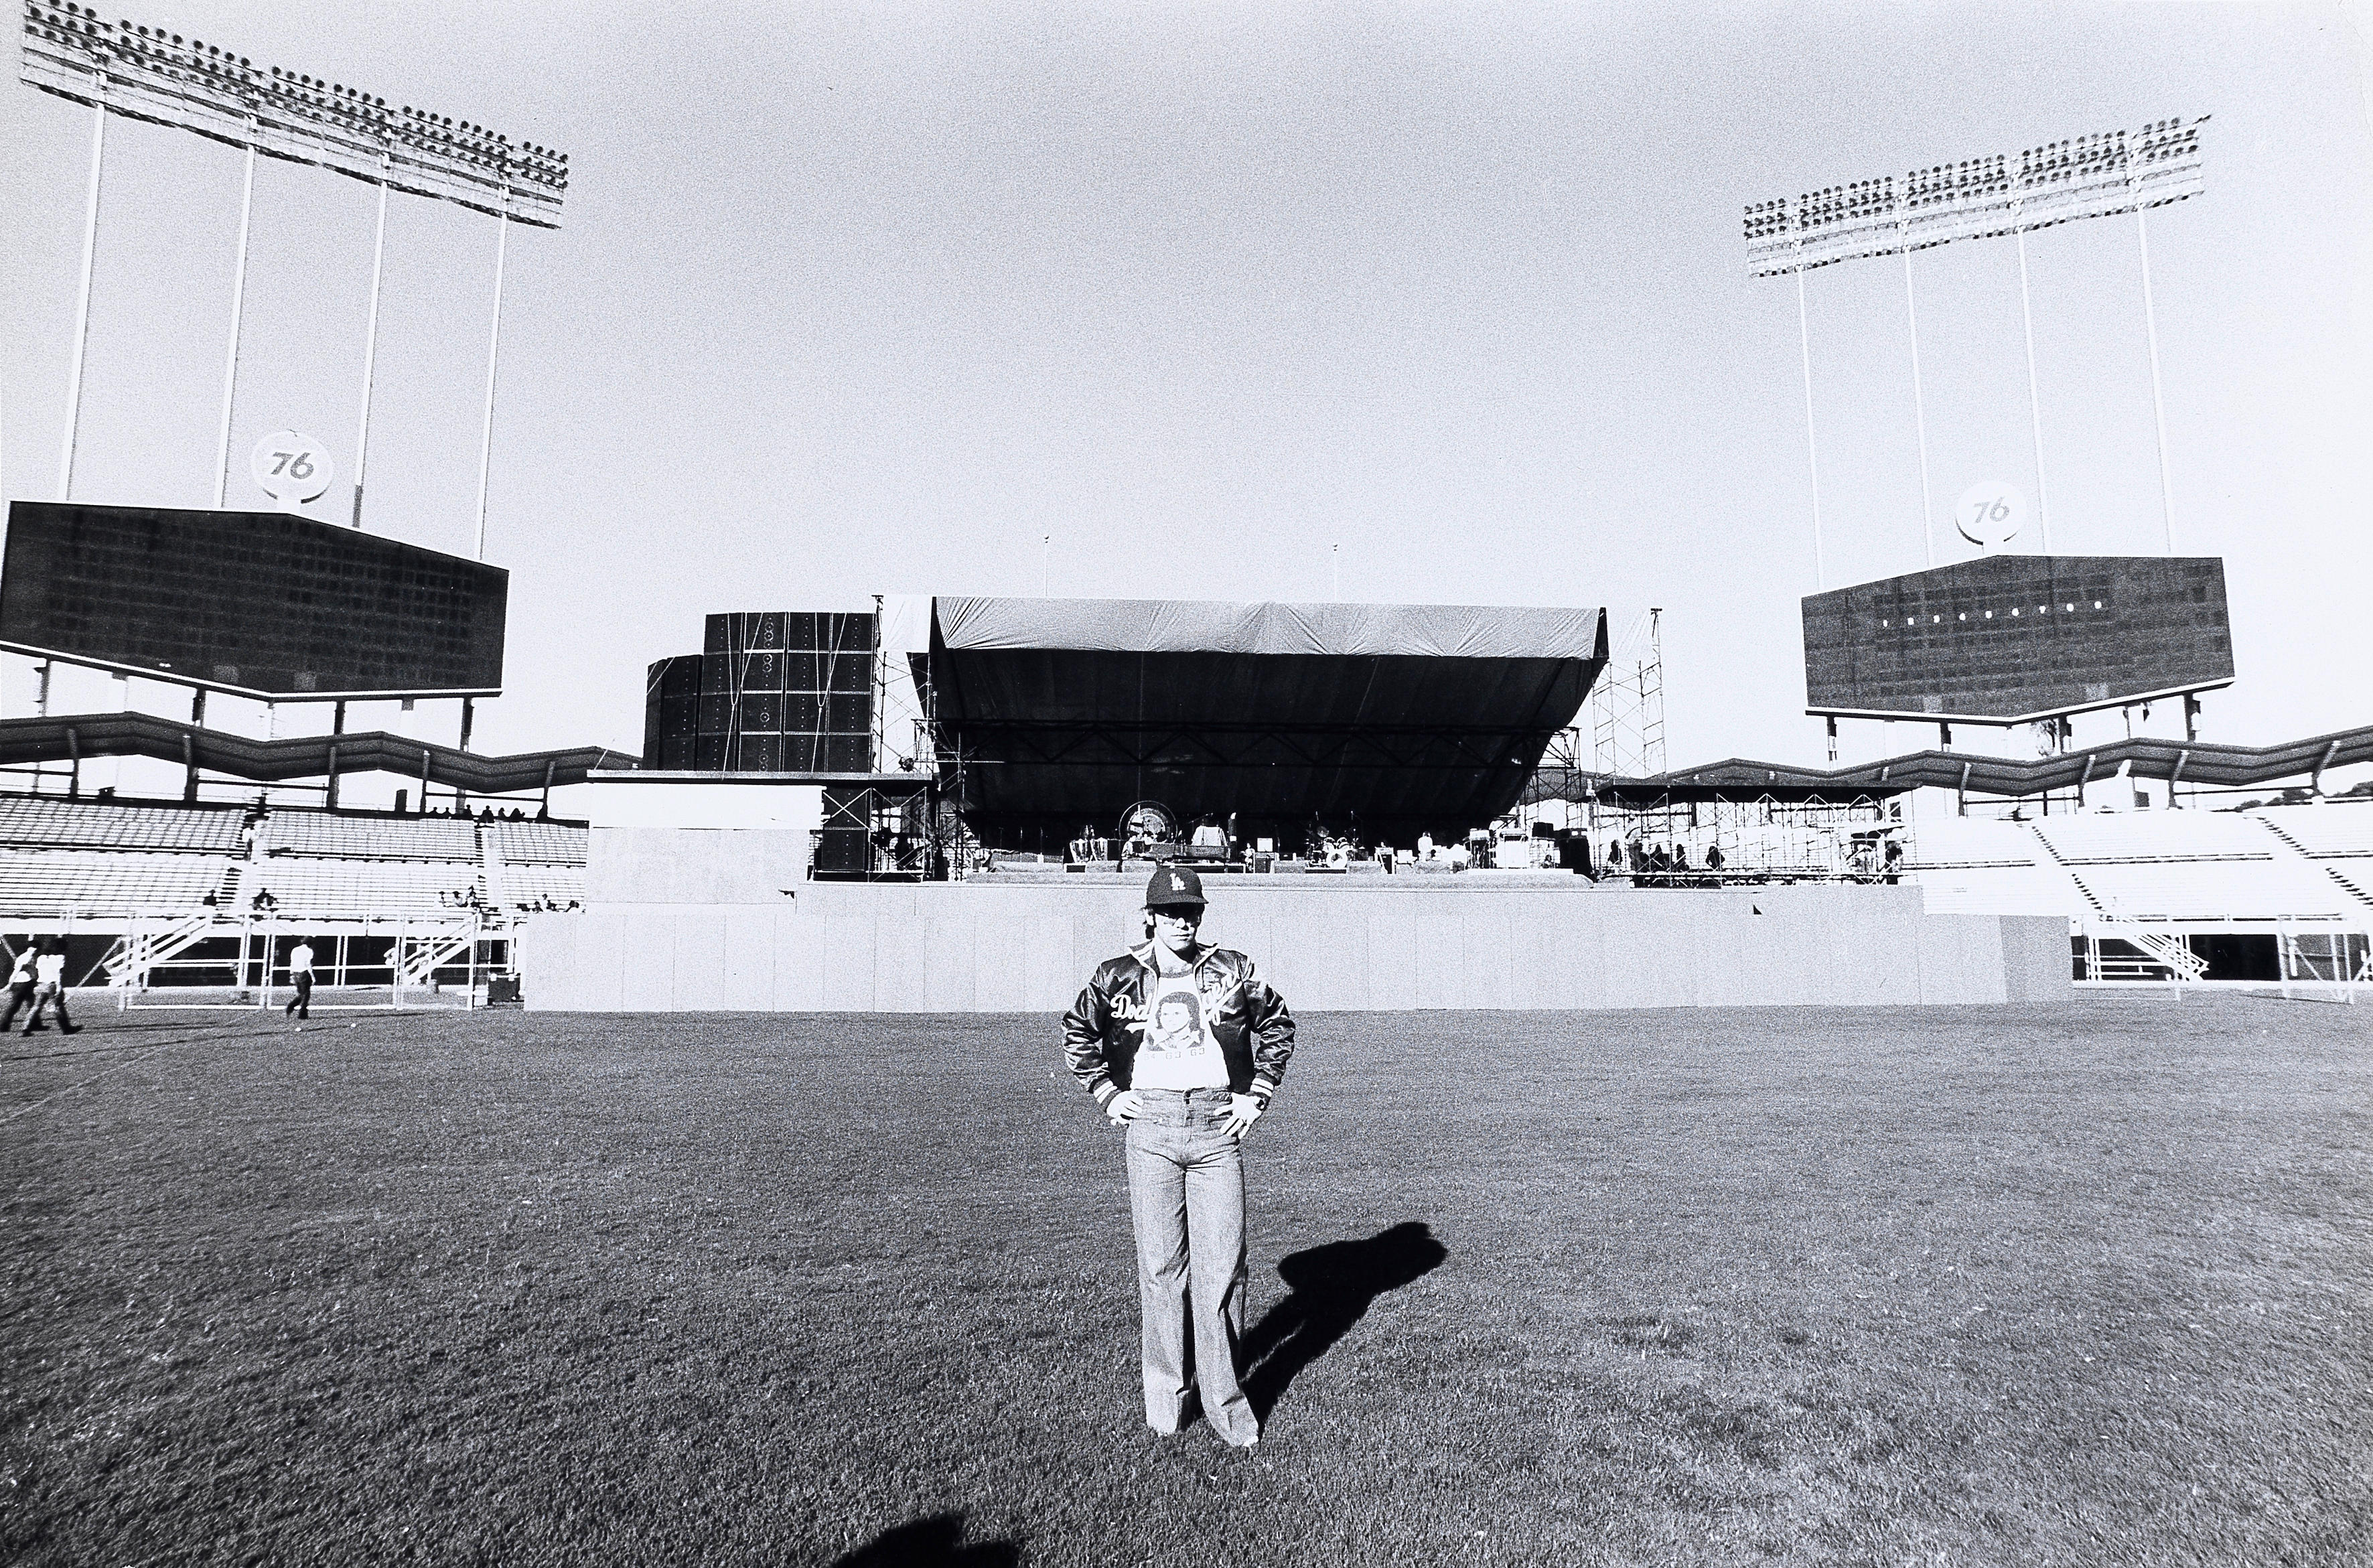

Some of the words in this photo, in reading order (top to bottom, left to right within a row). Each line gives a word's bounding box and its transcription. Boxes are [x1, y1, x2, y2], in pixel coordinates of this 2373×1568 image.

[271, 451, 314, 480] 76
[1973, 496, 2010, 523] 76
[1169, 873, 1185, 891] LA
